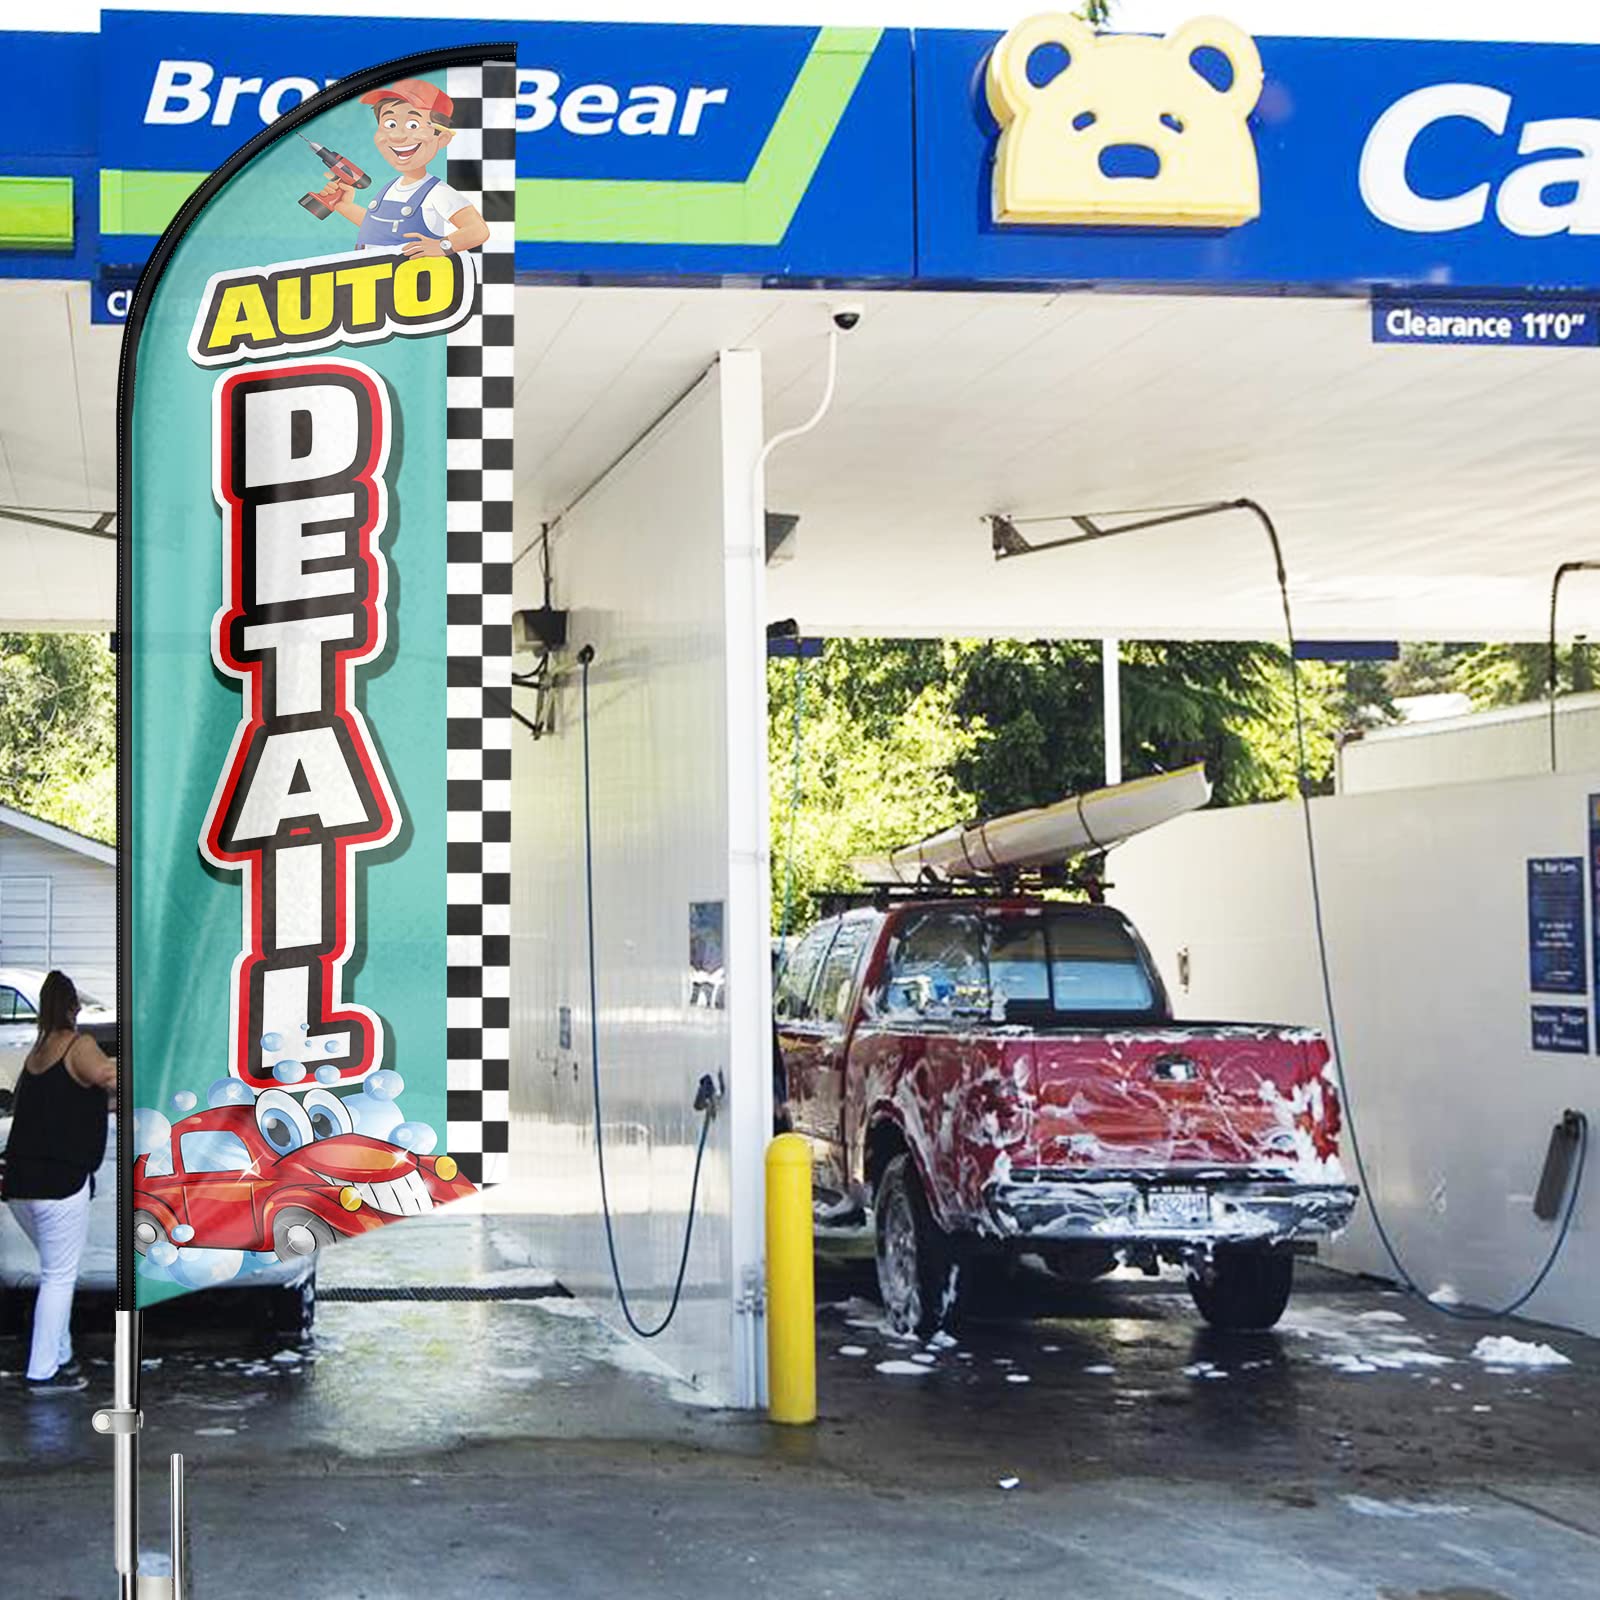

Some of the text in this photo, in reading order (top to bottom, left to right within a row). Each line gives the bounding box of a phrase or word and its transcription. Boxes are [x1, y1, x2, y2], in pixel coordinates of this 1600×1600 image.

[144, 60, 728, 135] Bro Bear
[207, 255, 455, 349] AUTO
[1386, 309, 1512, 338] Clearance
[230, 384, 370, 1068] DETAIL
